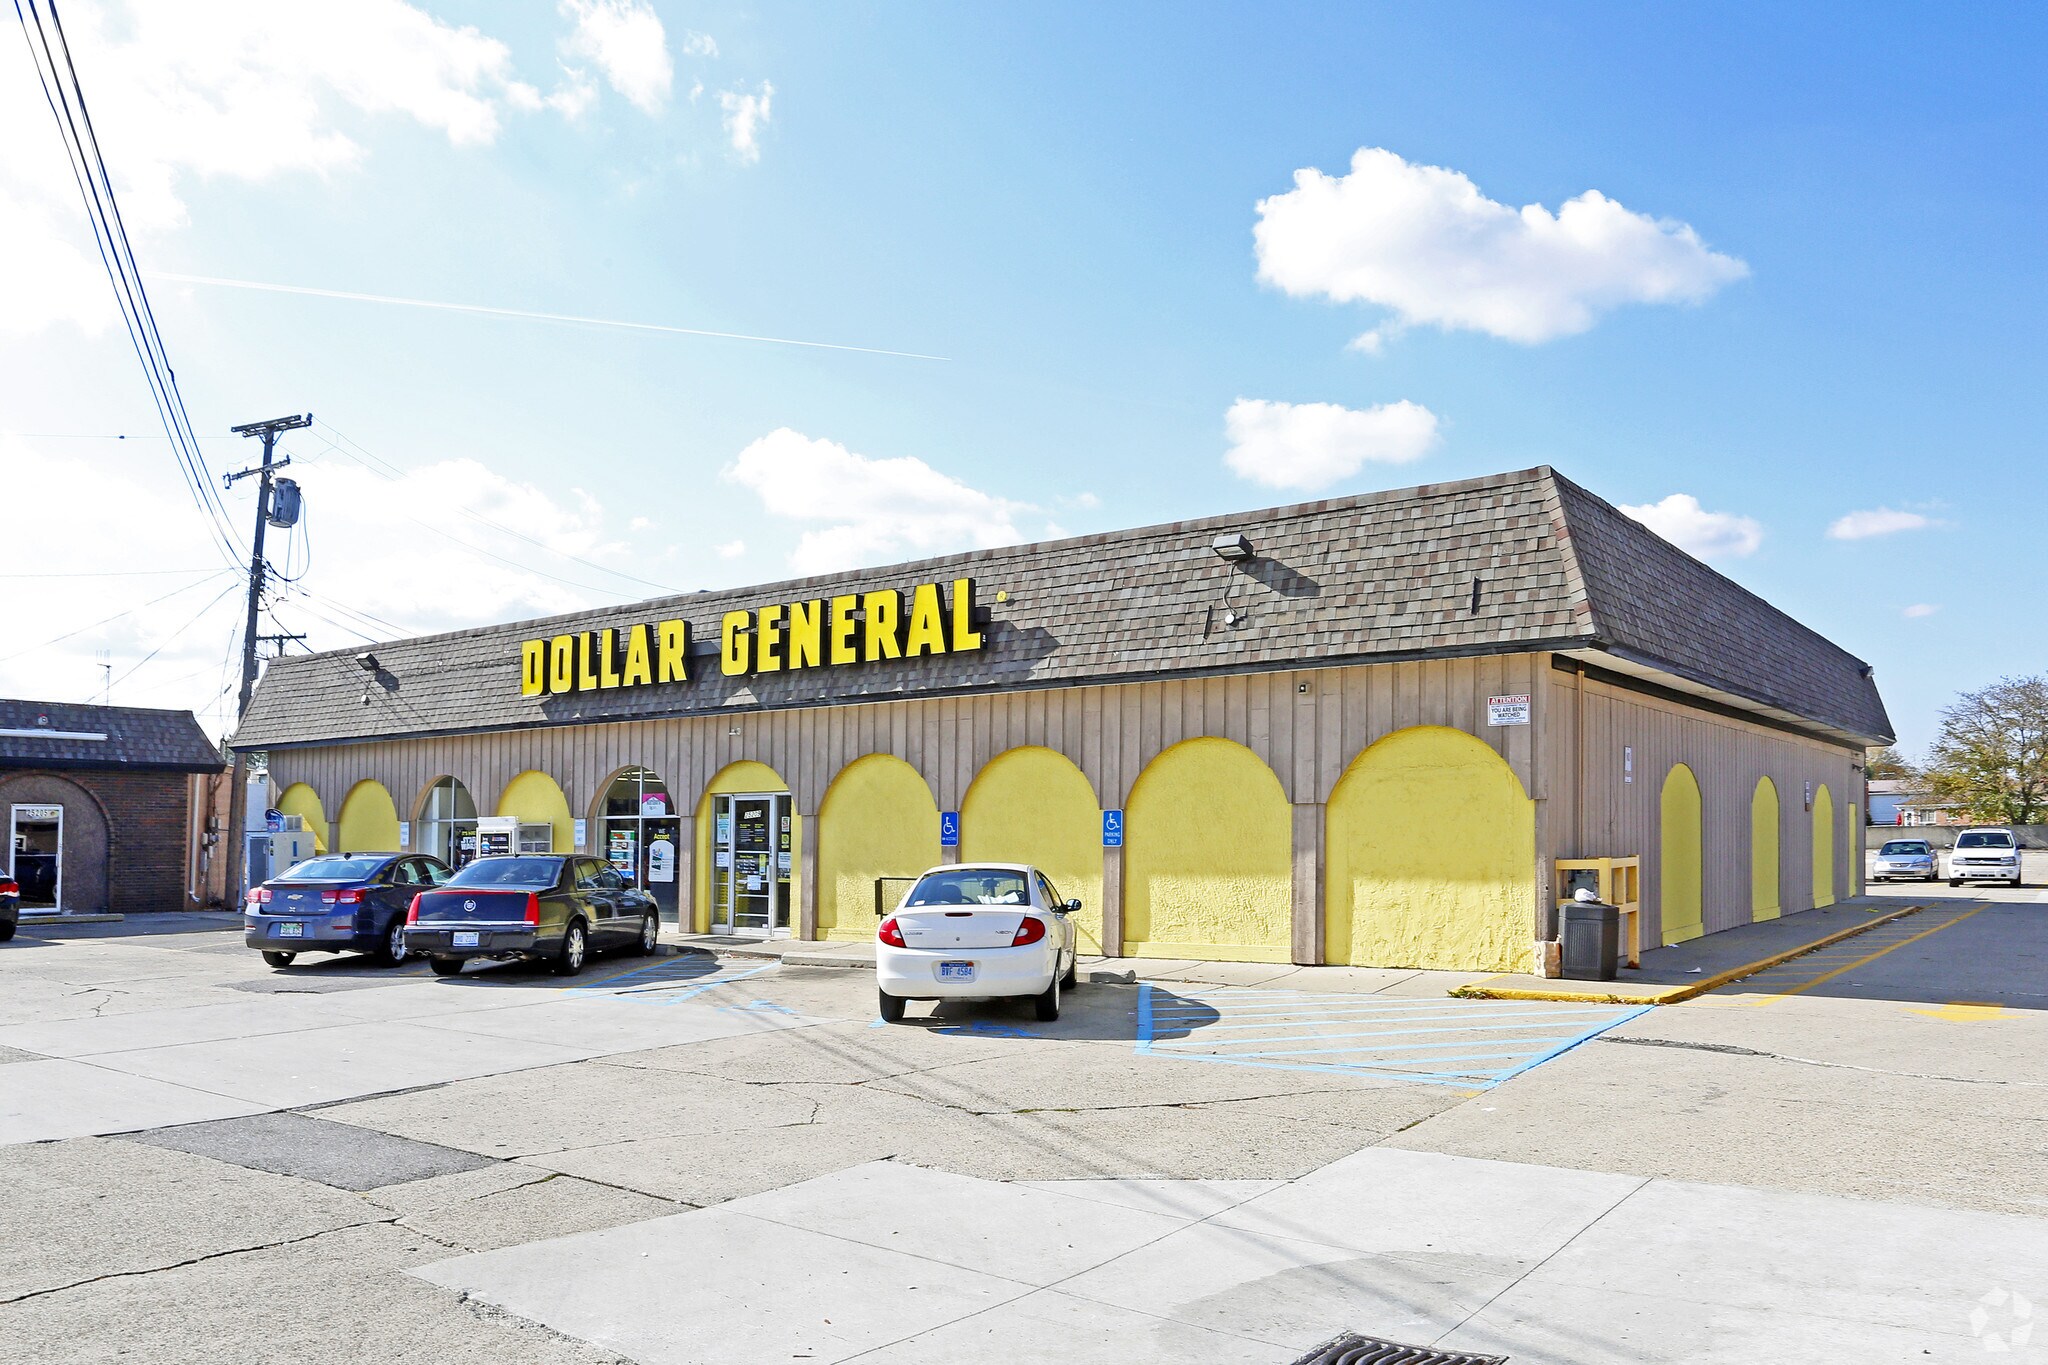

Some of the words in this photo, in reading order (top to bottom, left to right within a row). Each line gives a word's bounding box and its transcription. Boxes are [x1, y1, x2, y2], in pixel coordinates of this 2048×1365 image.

[521, 619, 688, 698] DOLLAR
[721, 578, 982, 677] GENERAL
[1490, 696, 1528, 704] ATTENTION
